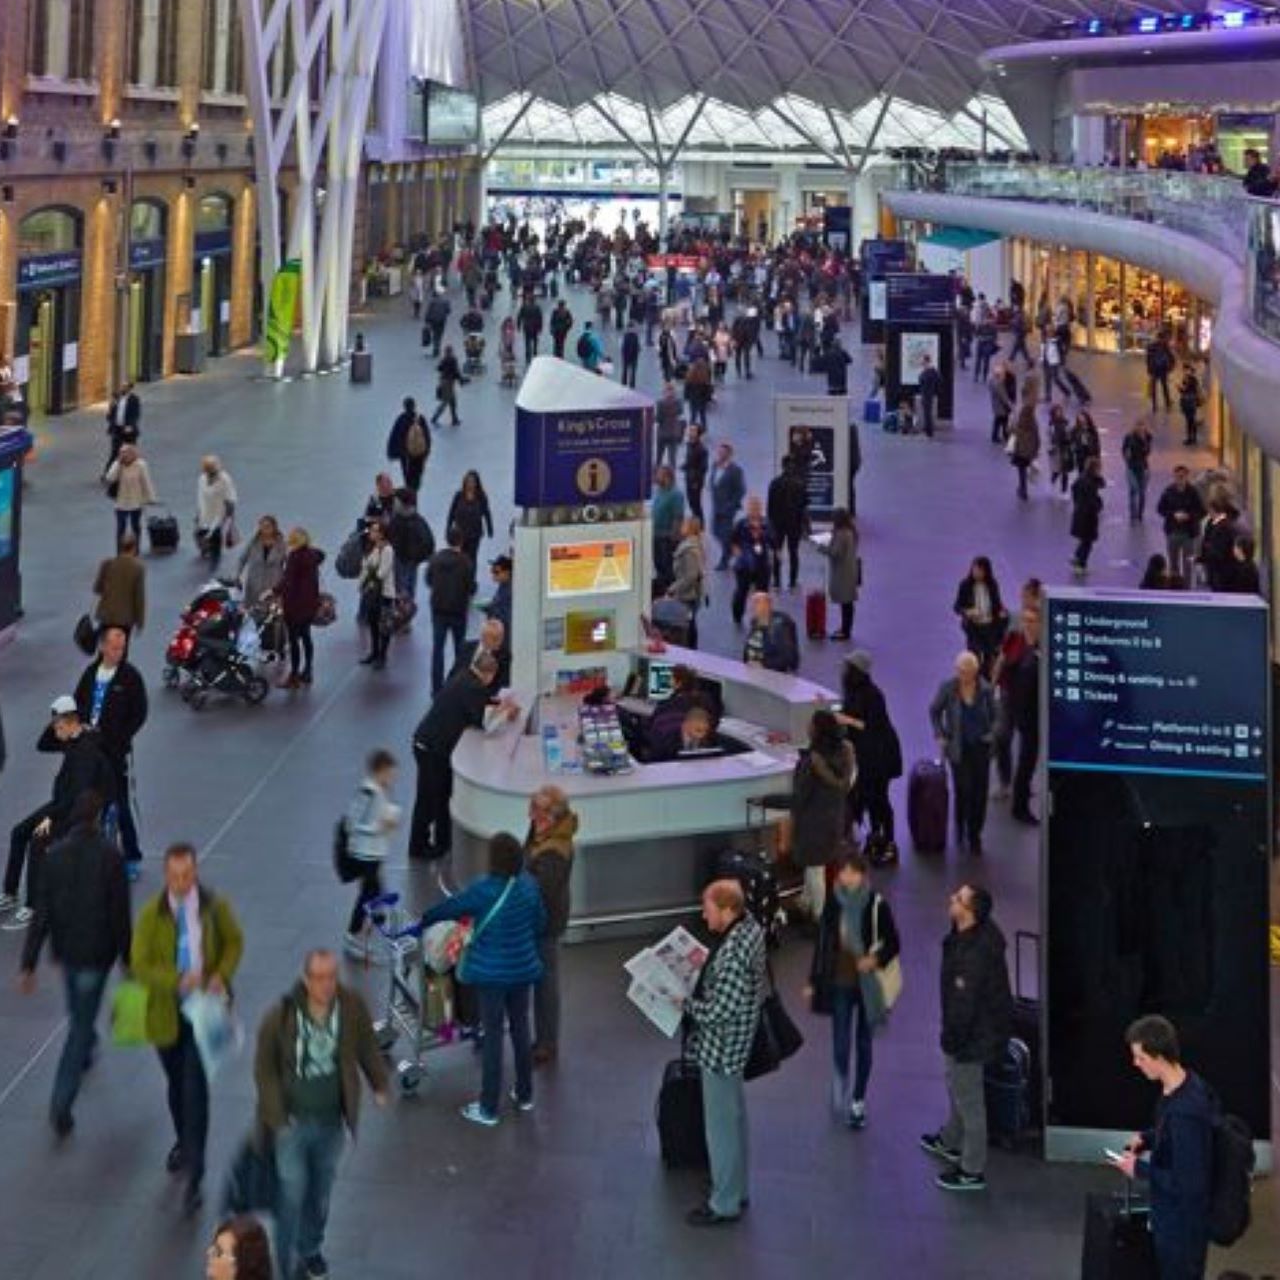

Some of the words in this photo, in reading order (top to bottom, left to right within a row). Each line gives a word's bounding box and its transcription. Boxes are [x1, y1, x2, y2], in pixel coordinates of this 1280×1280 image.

[1083, 615, 1149, 631] Underground
[1083, 633, 1132, 647] Platforms
[1083, 670, 1116, 685] Dining
[1083, 689, 1119, 702] Tickets
